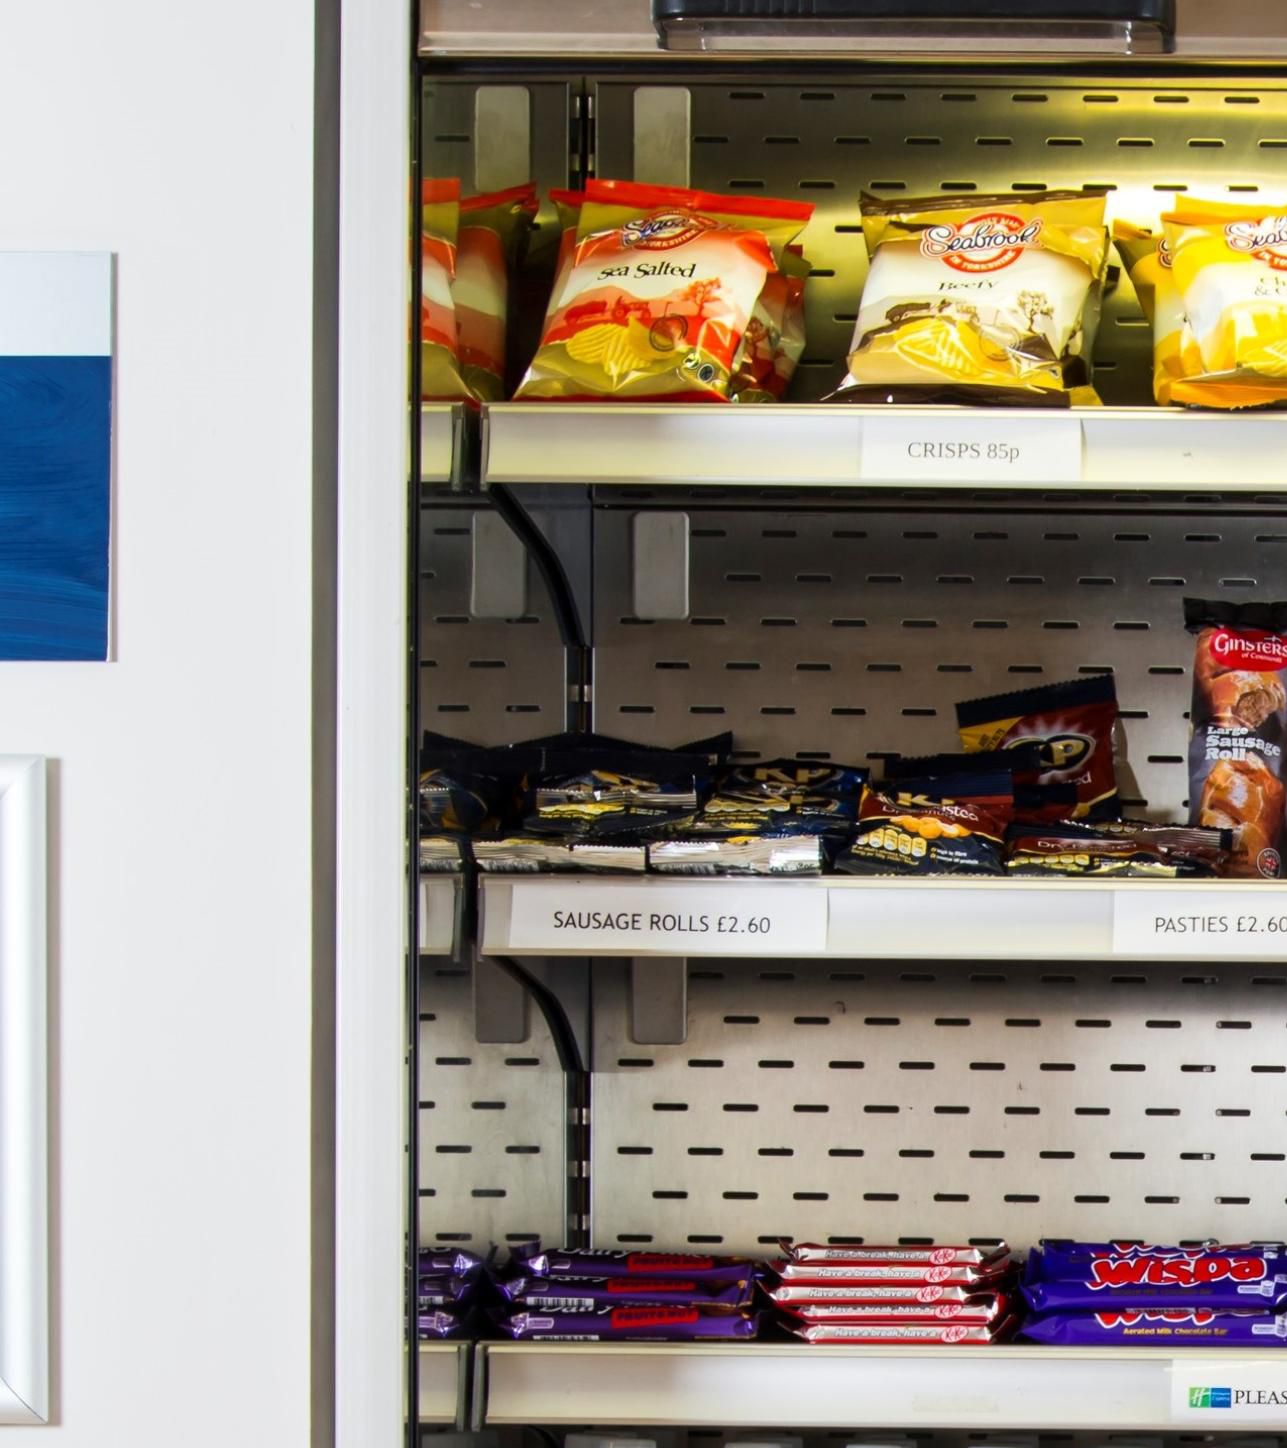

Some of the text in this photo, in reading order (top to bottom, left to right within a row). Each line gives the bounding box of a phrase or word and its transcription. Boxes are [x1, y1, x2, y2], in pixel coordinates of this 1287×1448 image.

[925, 220, 1041, 256] Seabrook
[633, 261, 697, 280] Salted
[907, 441, 1020, 463] CRISPS 85p
[1207, 725, 1249, 737] Large
[1204, 747, 1246, 762] Roll
[1205, 735, 1281, 757] Sausage
[553, 910, 771, 934] SAUSAGE ROLLS £2.60
[1155, 915, 1229, 933] PASTIES
